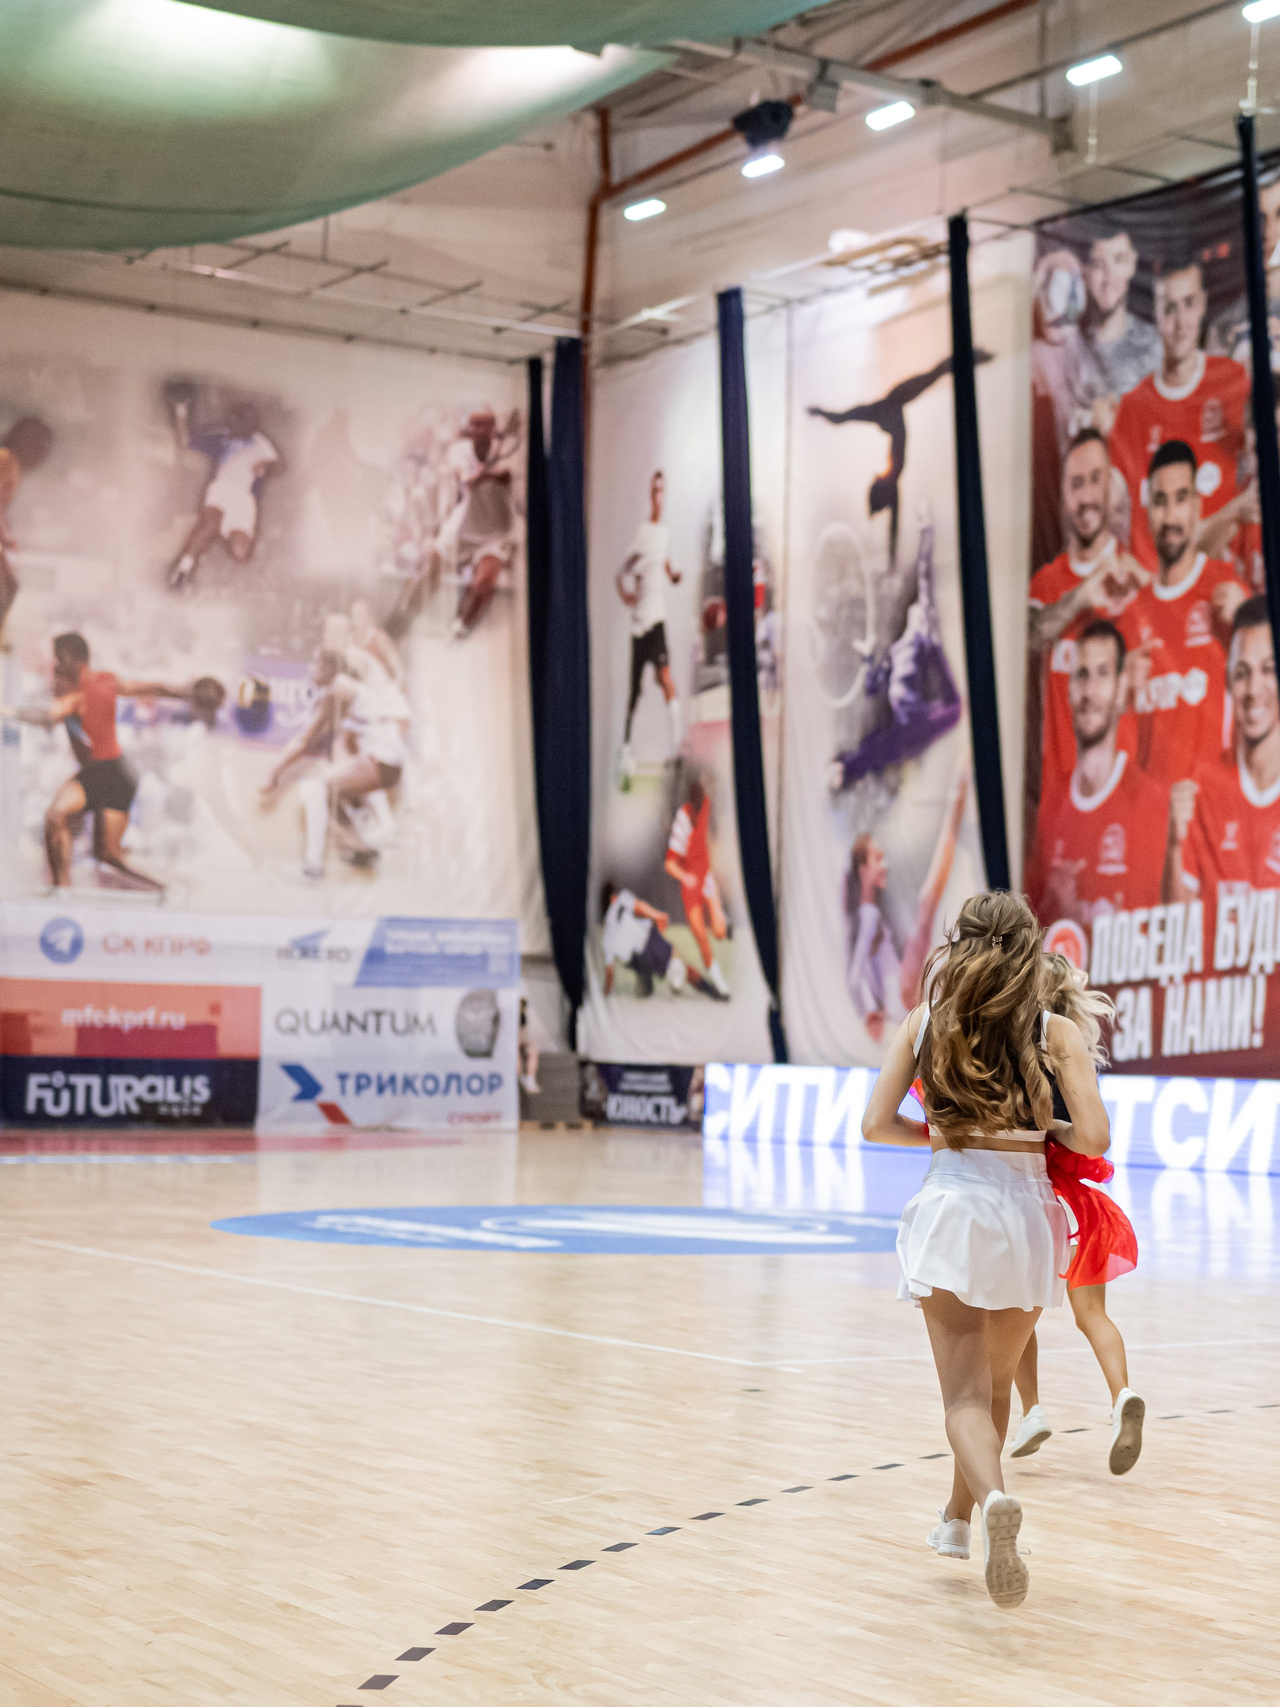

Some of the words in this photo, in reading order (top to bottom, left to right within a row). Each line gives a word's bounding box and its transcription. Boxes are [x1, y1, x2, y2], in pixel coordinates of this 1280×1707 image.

[1090, 900, 1204, 986] ПОБЕДА
[275, 1007, 437, 1036] QUANTUM
[1112, 985, 1153, 1062] ЗА
[1161, 973, 1267, 1058] НАМИ!
[336, 1072, 503, 1097] ТРИКОЛОР
